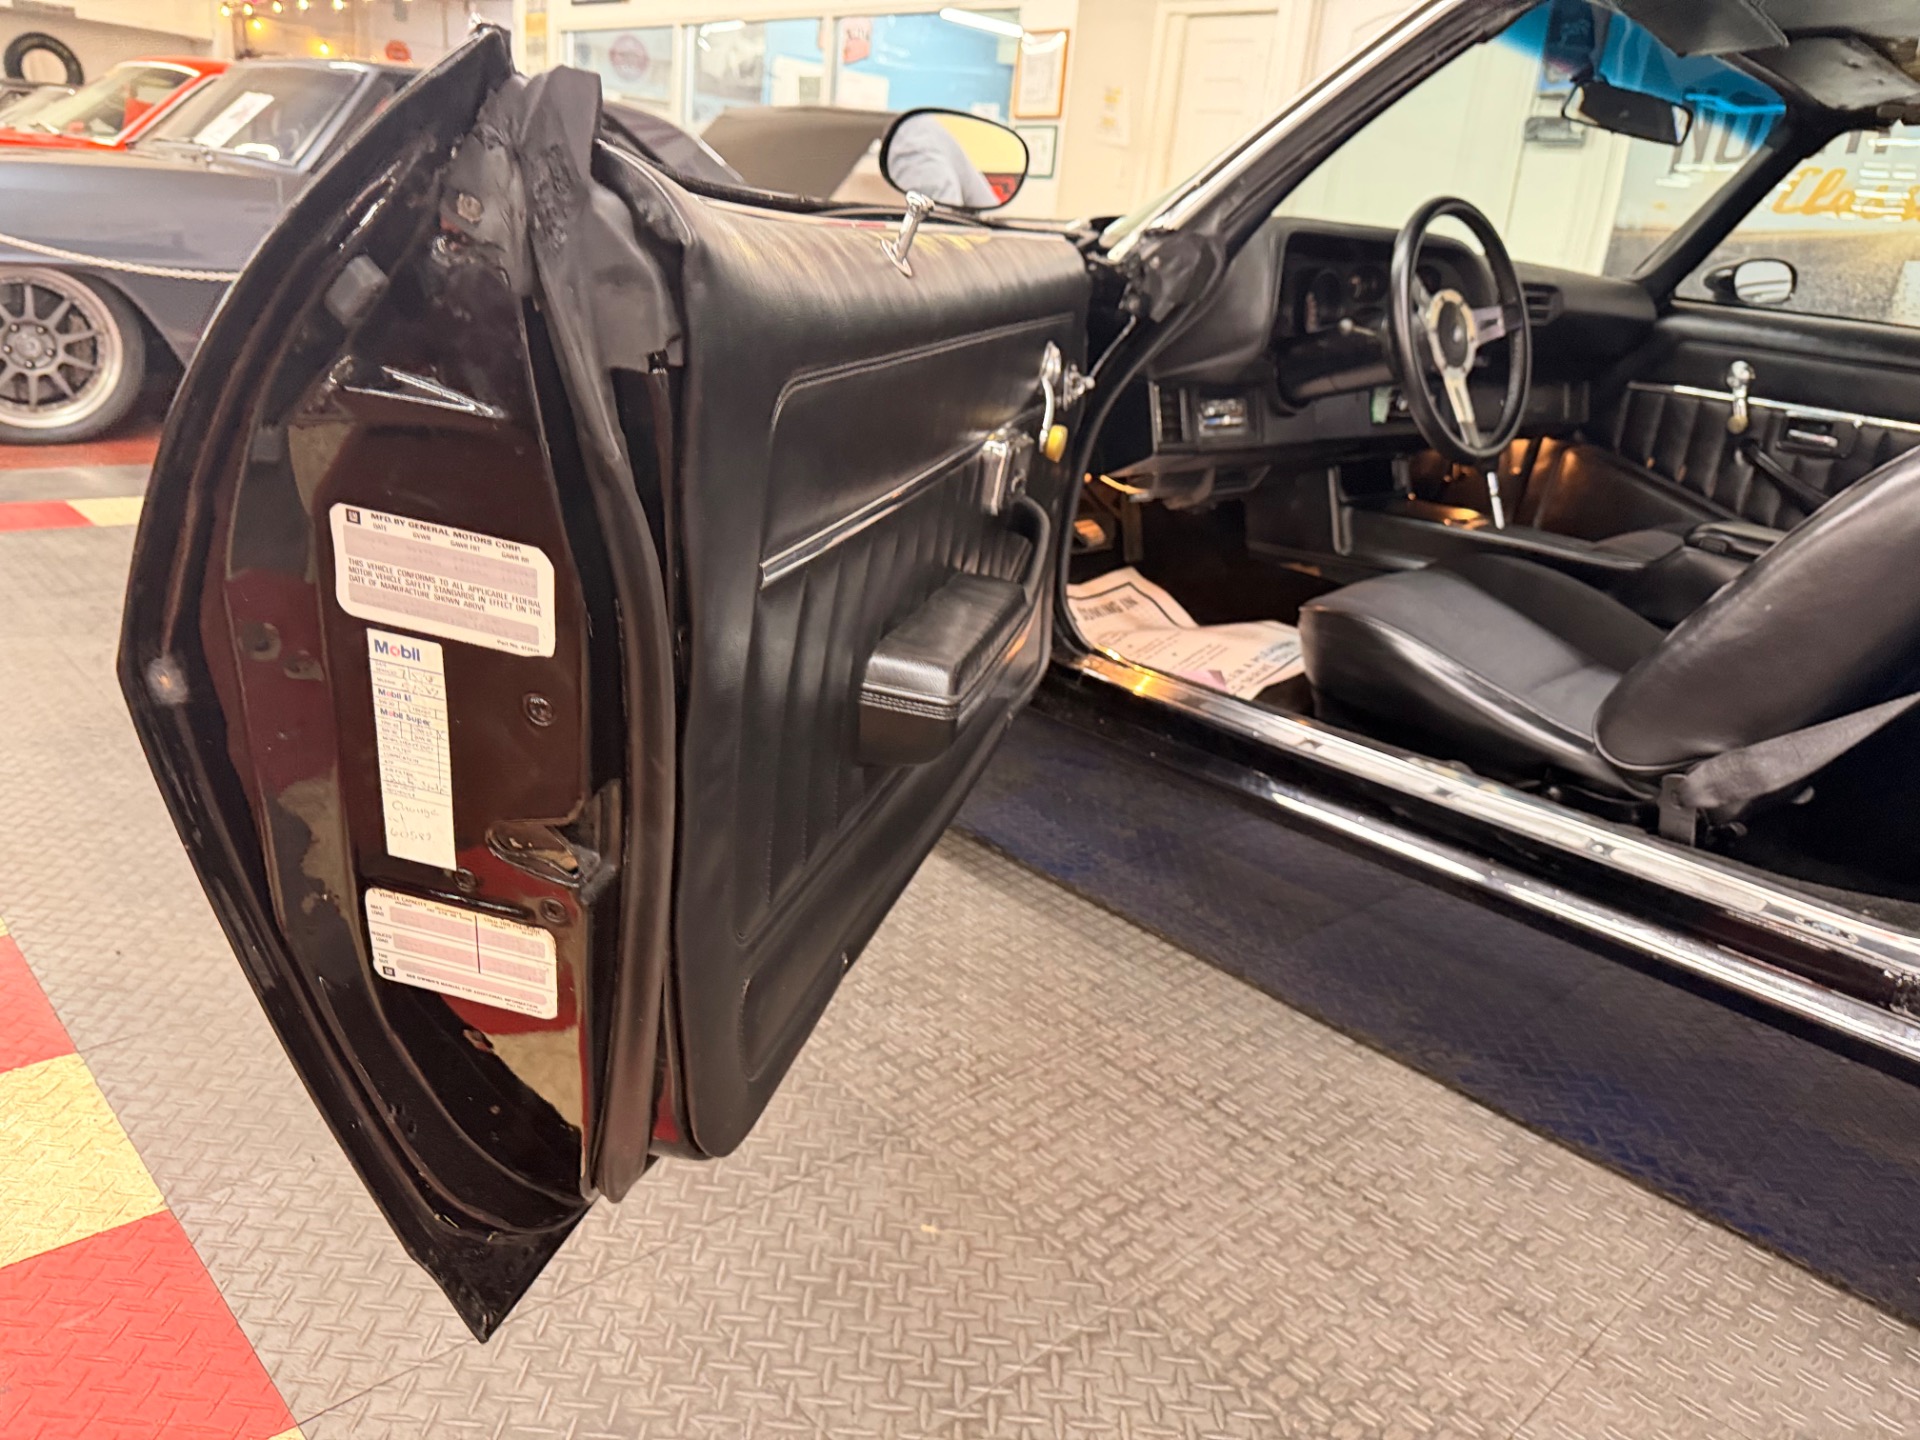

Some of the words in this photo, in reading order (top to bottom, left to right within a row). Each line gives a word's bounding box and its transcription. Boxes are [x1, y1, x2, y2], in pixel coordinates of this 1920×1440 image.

[394, 518, 405, 527] BY
[408, 521, 450, 537] GENERAL
[452, 531, 492, 546] MOTORS
[348, 558, 364, 567] THIS
[366, 561, 393, 574] VEHICLE
[397, 569, 436, 584] CONFORMS
[439, 578, 449, 587] TO
[452, 581, 464, 591] ALL
[467, 585, 508, 600] APPLICABLE
[511, 595, 541, 608] FEDERAL
[348, 566, 373, 577] MOTOR
[375, 572, 401, 585] VEHICLE
[405, 579, 431, 591] SAFETY
[433, 585, 475, 602] STANDARDS
[478, 596, 486, 604] IN
[489, 598, 512, 610] EFFECT
[515, 604, 526, 613] ON
[529, 607, 542, 617] THE
[348, 574, 365, 585] DATE
[368, 578, 377, 586] OF
[380, 582, 430, 598] MANUFACTURE
[433, 593, 460, 606] SHOWN
[463, 601, 485, 612] ABOVE
[373, 639, 421, 662] Mobil
[378, 687, 401, 700] Mobil
[380, 708, 403, 720] Mobil
[406, 713, 431, 727] Super
